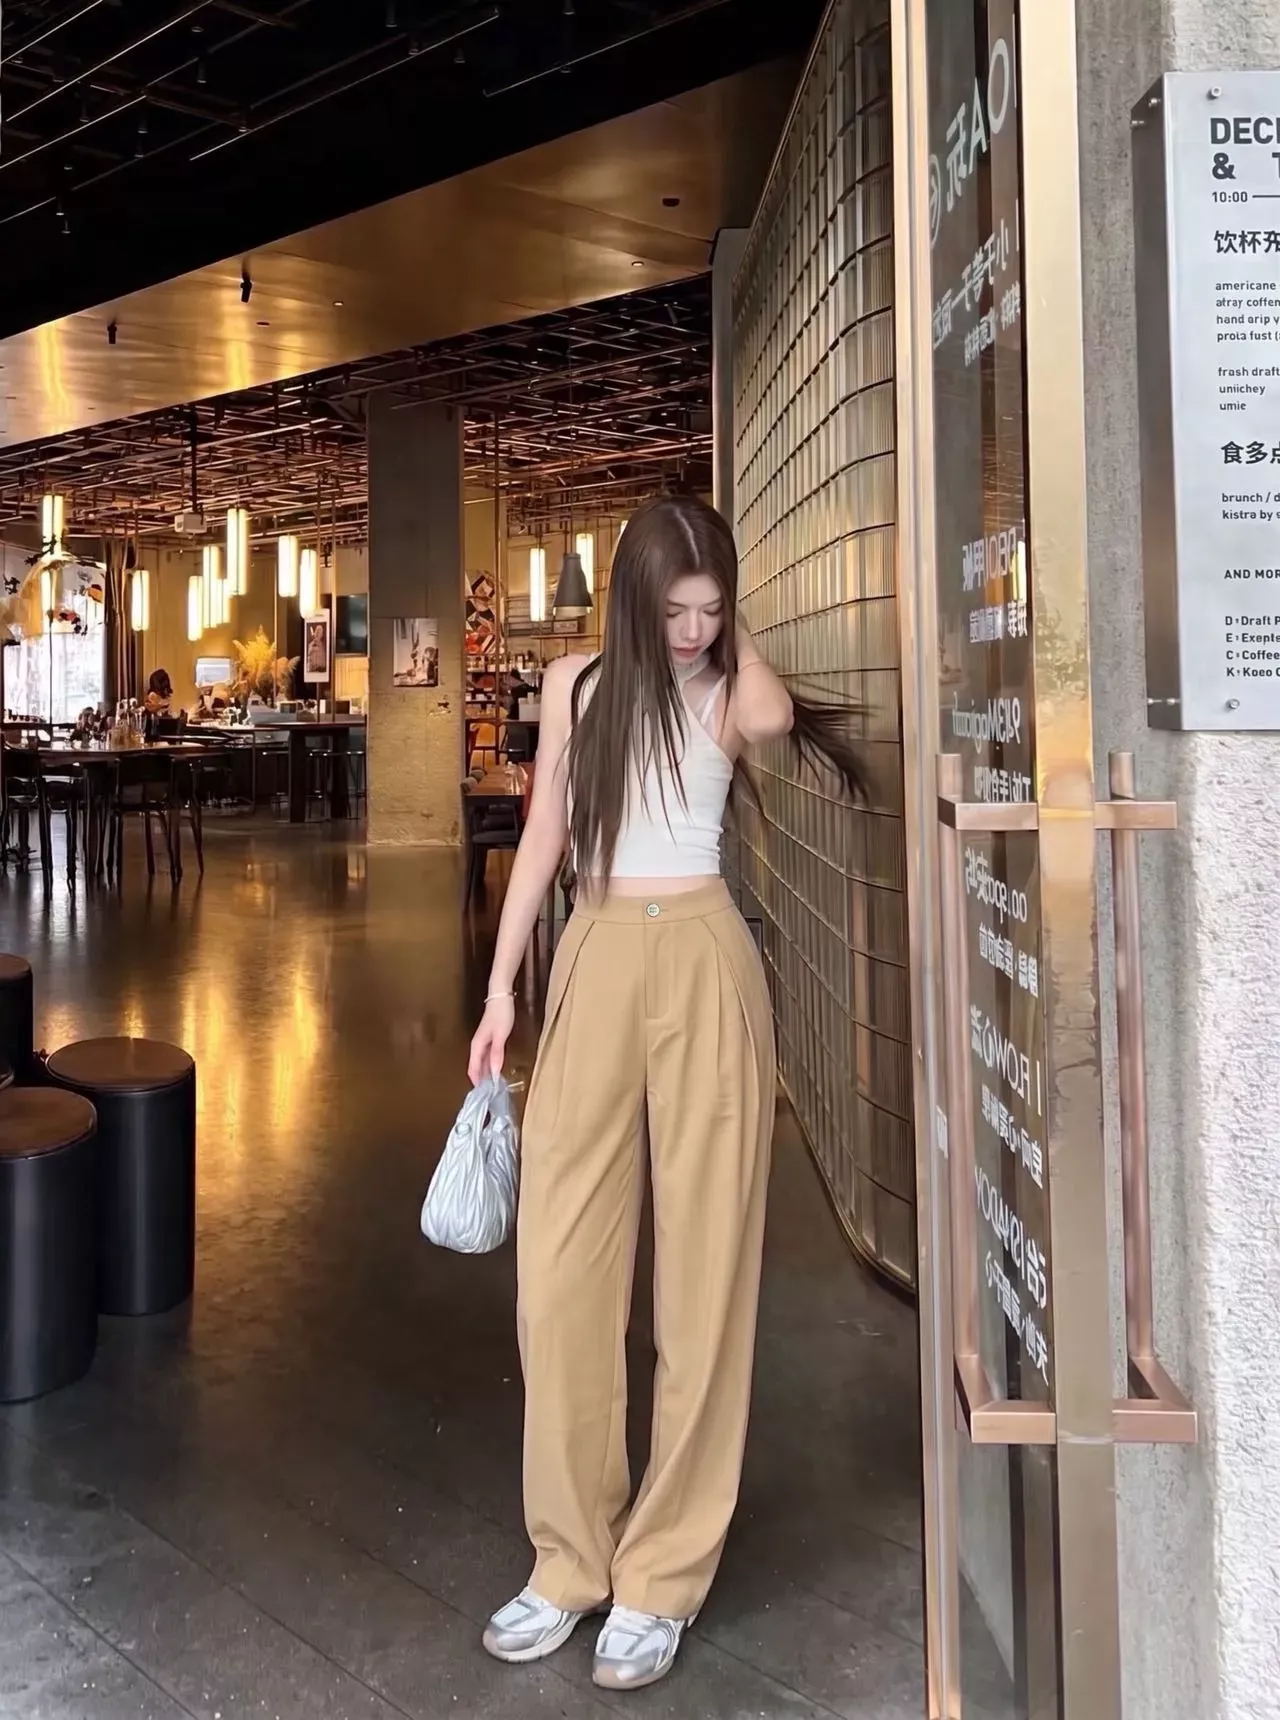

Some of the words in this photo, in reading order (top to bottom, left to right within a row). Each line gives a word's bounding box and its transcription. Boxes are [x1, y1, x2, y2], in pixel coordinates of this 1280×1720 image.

[1210, 117, 1280, 144] DEC
[1211, 152, 1237, 180] &
[1212, 191, 1248, 203] 10:00
[1216, 314, 1245, 324] hand
[1249, 331, 1272, 341] fust
[1221, 492, 1263, 503] brunch
[1259, 509, 1274, 522] by
[1224, 569, 1251, 579] AND
